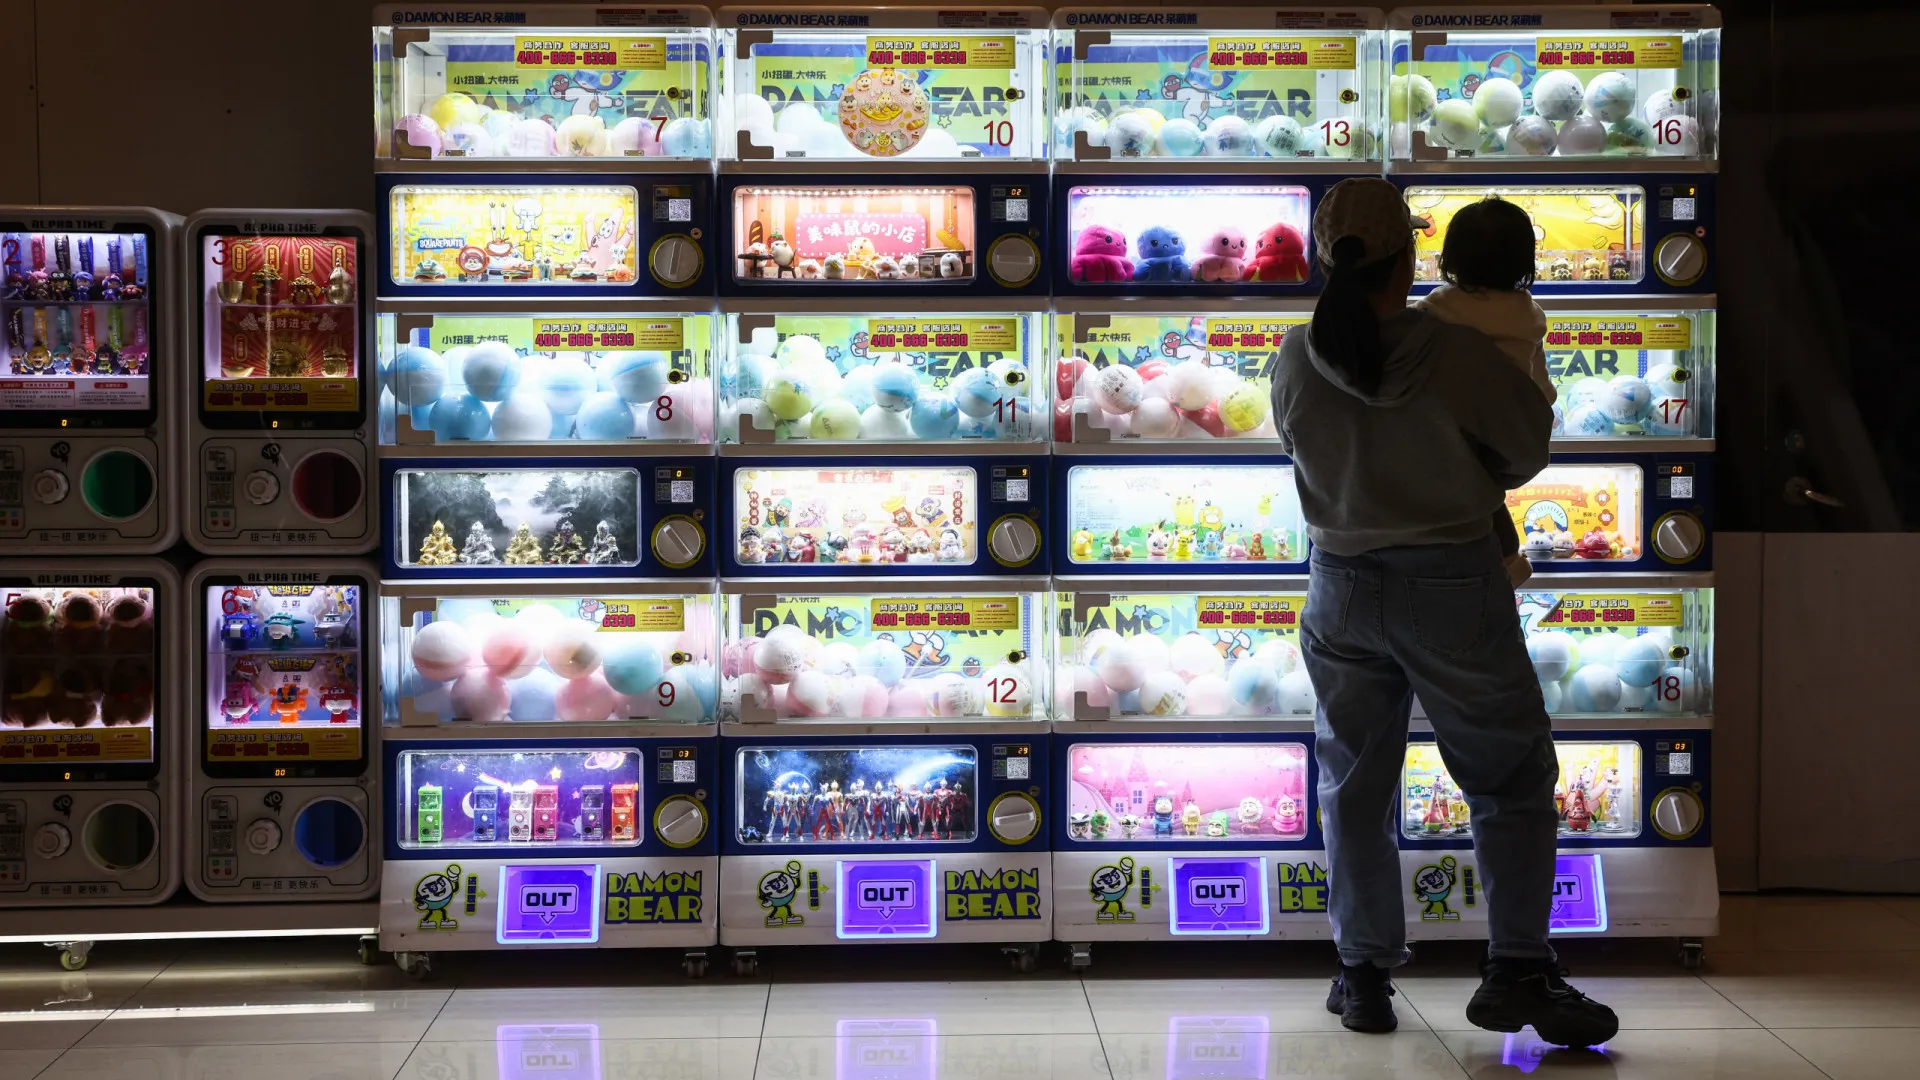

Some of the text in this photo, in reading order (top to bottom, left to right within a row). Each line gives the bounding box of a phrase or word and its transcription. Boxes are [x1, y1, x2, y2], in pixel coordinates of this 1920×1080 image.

[455, 11, 491, 24] BEAR
[800, 13, 835, 26] BEAR
[1129, 13, 1164, 26] BEAR
[1474, 14, 1509, 27] BEAR
[523, 41, 611, 50] 商务合作 客服咨询
[875, 41, 960, 50] 商务合作 客服咨询
[1216, 41, 1302, 50] 商务合作 客服咨询
[1544, 41, 1628, 50] 商务合作 客服咨询
[516, 50, 617, 65] 400-666-6338
[868, 51, 967, 64] 400-666-6338
[1210, 51, 1308, 65] 400-666-6338
[1538, 51, 1635, 65] 400-666-6338
[650, 117, 668, 142] 7
[984, 121, 1014, 146] 10
[1321, 121, 1350, 146] 13
[1652, 119, 1682, 144] 16
[1689, 187, 1695, 195] 9
[31, 220, 106, 229] ALPHA TIME
[244, 223, 316, 232] ALPHA TIME
[807, 221, 917, 244] 美味鼠的小店
[2, 239, 22, 266] 2
[212, 239, 228, 265] 3
[541, 323, 627, 332] 商务合作 客服咨询
[877, 323, 961, 332] 商务合作 客服咨询
[1553, 322, 1636, 330] 商务合作 客服咨询
[535, 332, 634, 346] 400-666-6338
[870, 333, 968, 347] 400-666-6338
[1208, 333, 1284, 347] 400-666-6
[1546, 332, 1642, 344] 400-666-6338
[655, 395, 673, 421] 8
[992, 397, 1016, 423] 11
[1659, 398, 1688, 424] 17
[62, 419, 67, 427] 0
[1022, 468, 1027, 476] 9
[38, 574, 112, 584] ALPHA TIME
[248, 573, 320, 582] ALPHA TIME
[5, 593, 22, 618] 5
[221, 590, 239, 614] 6
[925, 603, 963, 611] 客服咨询
[1206, 601, 1289, 610] 商务合作 客服咨询
[873, 612, 970, 626] 400-666-6338
[1200, 611, 1296, 625] 400-666-6338
[1550, 608, 1635, 622] 0-666-6338
[658, 681, 675, 707] 9
[987, 677, 1017, 703] 12
[1651, 675, 1681, 701] 18
[65, 772, 70, 780] 0
[946, 868, 1038, 890] DAMON
[1279, 862, 1328, 883] DAM
[608, 871, 703, 894] DAMON
[525, 891, 572, 907] OUT
[863, 887, 909, 902] OUT
[1195, 884, 1240, 900] OUT
[1280, 886, 1327, 910] BE
[607, 895, 702, 921] BEAR
[945, 892, 1039, 917] BEAR
